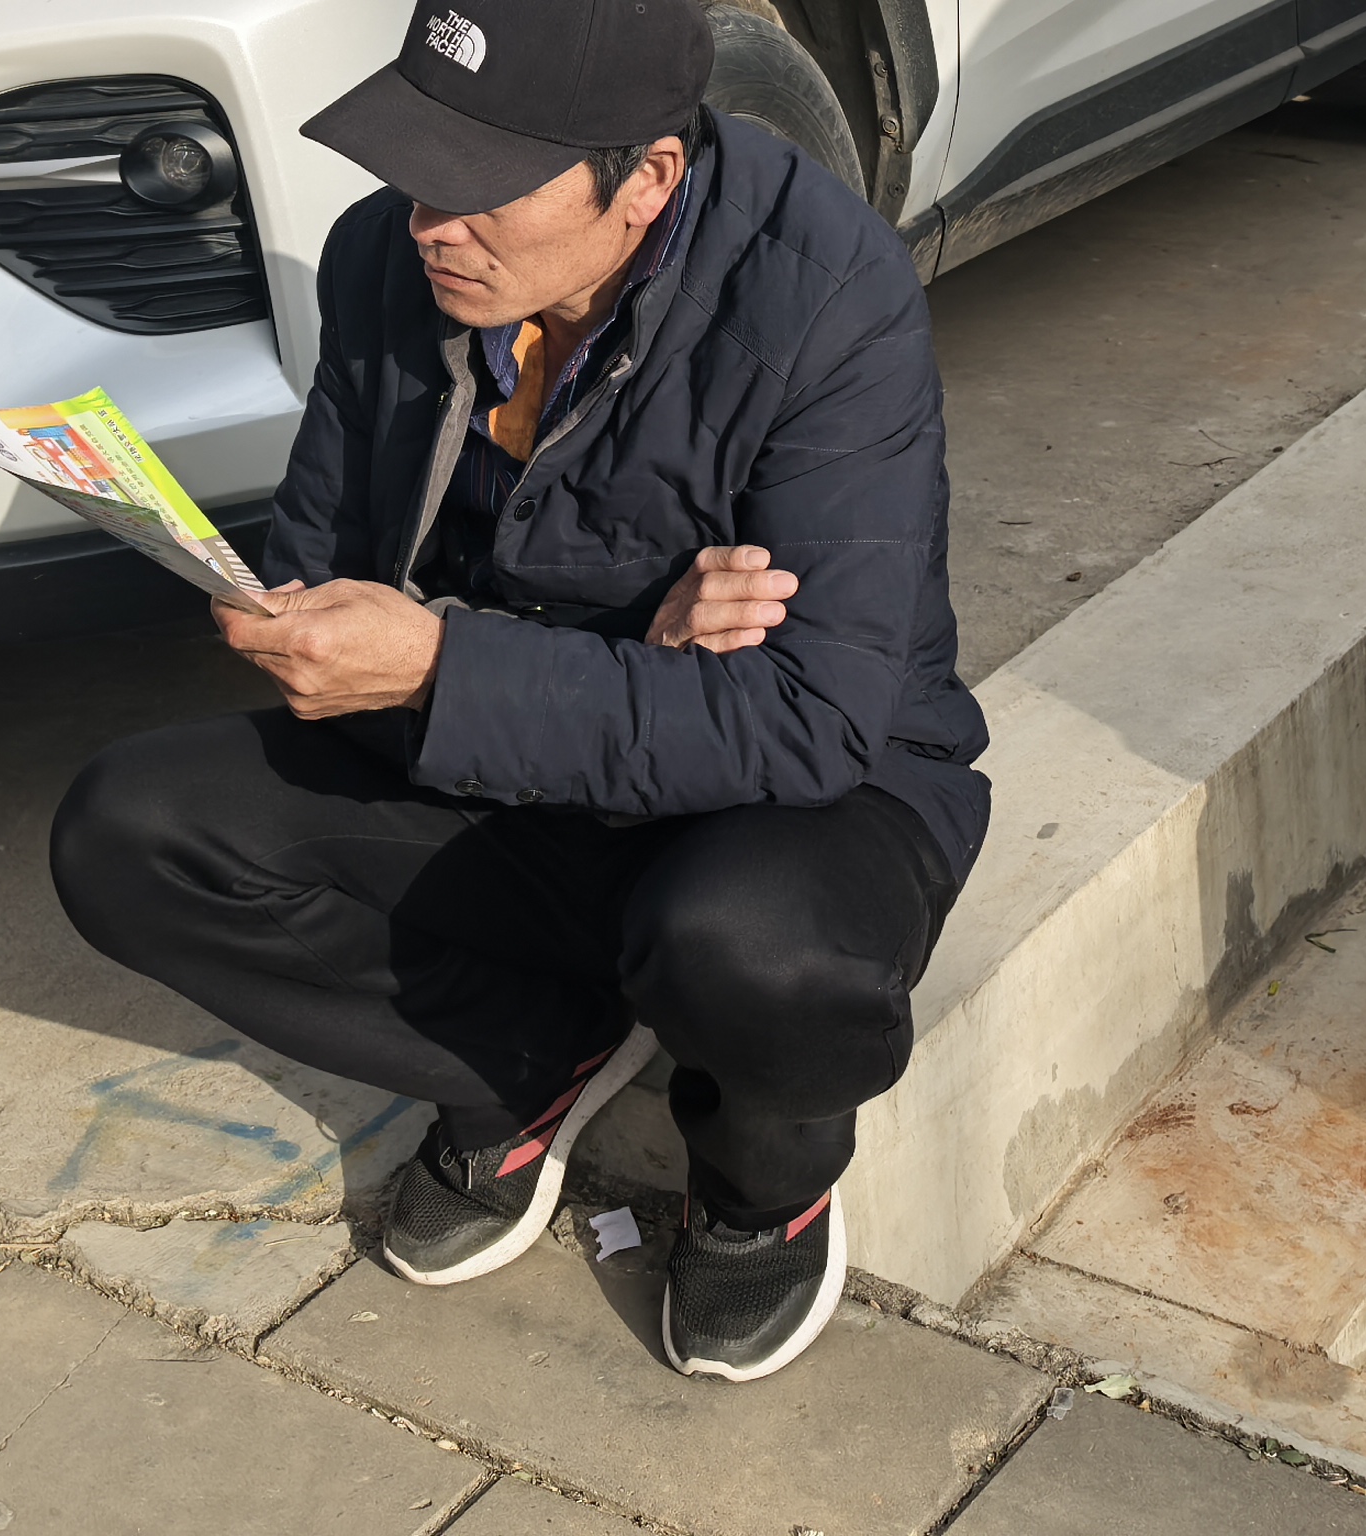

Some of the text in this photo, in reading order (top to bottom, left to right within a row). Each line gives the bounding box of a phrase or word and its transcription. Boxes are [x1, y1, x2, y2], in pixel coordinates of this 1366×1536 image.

[426, 15, 466, 49] NORTH
[447, 9, 472, 33] THE
[426, 32, 457, 58] FACE
